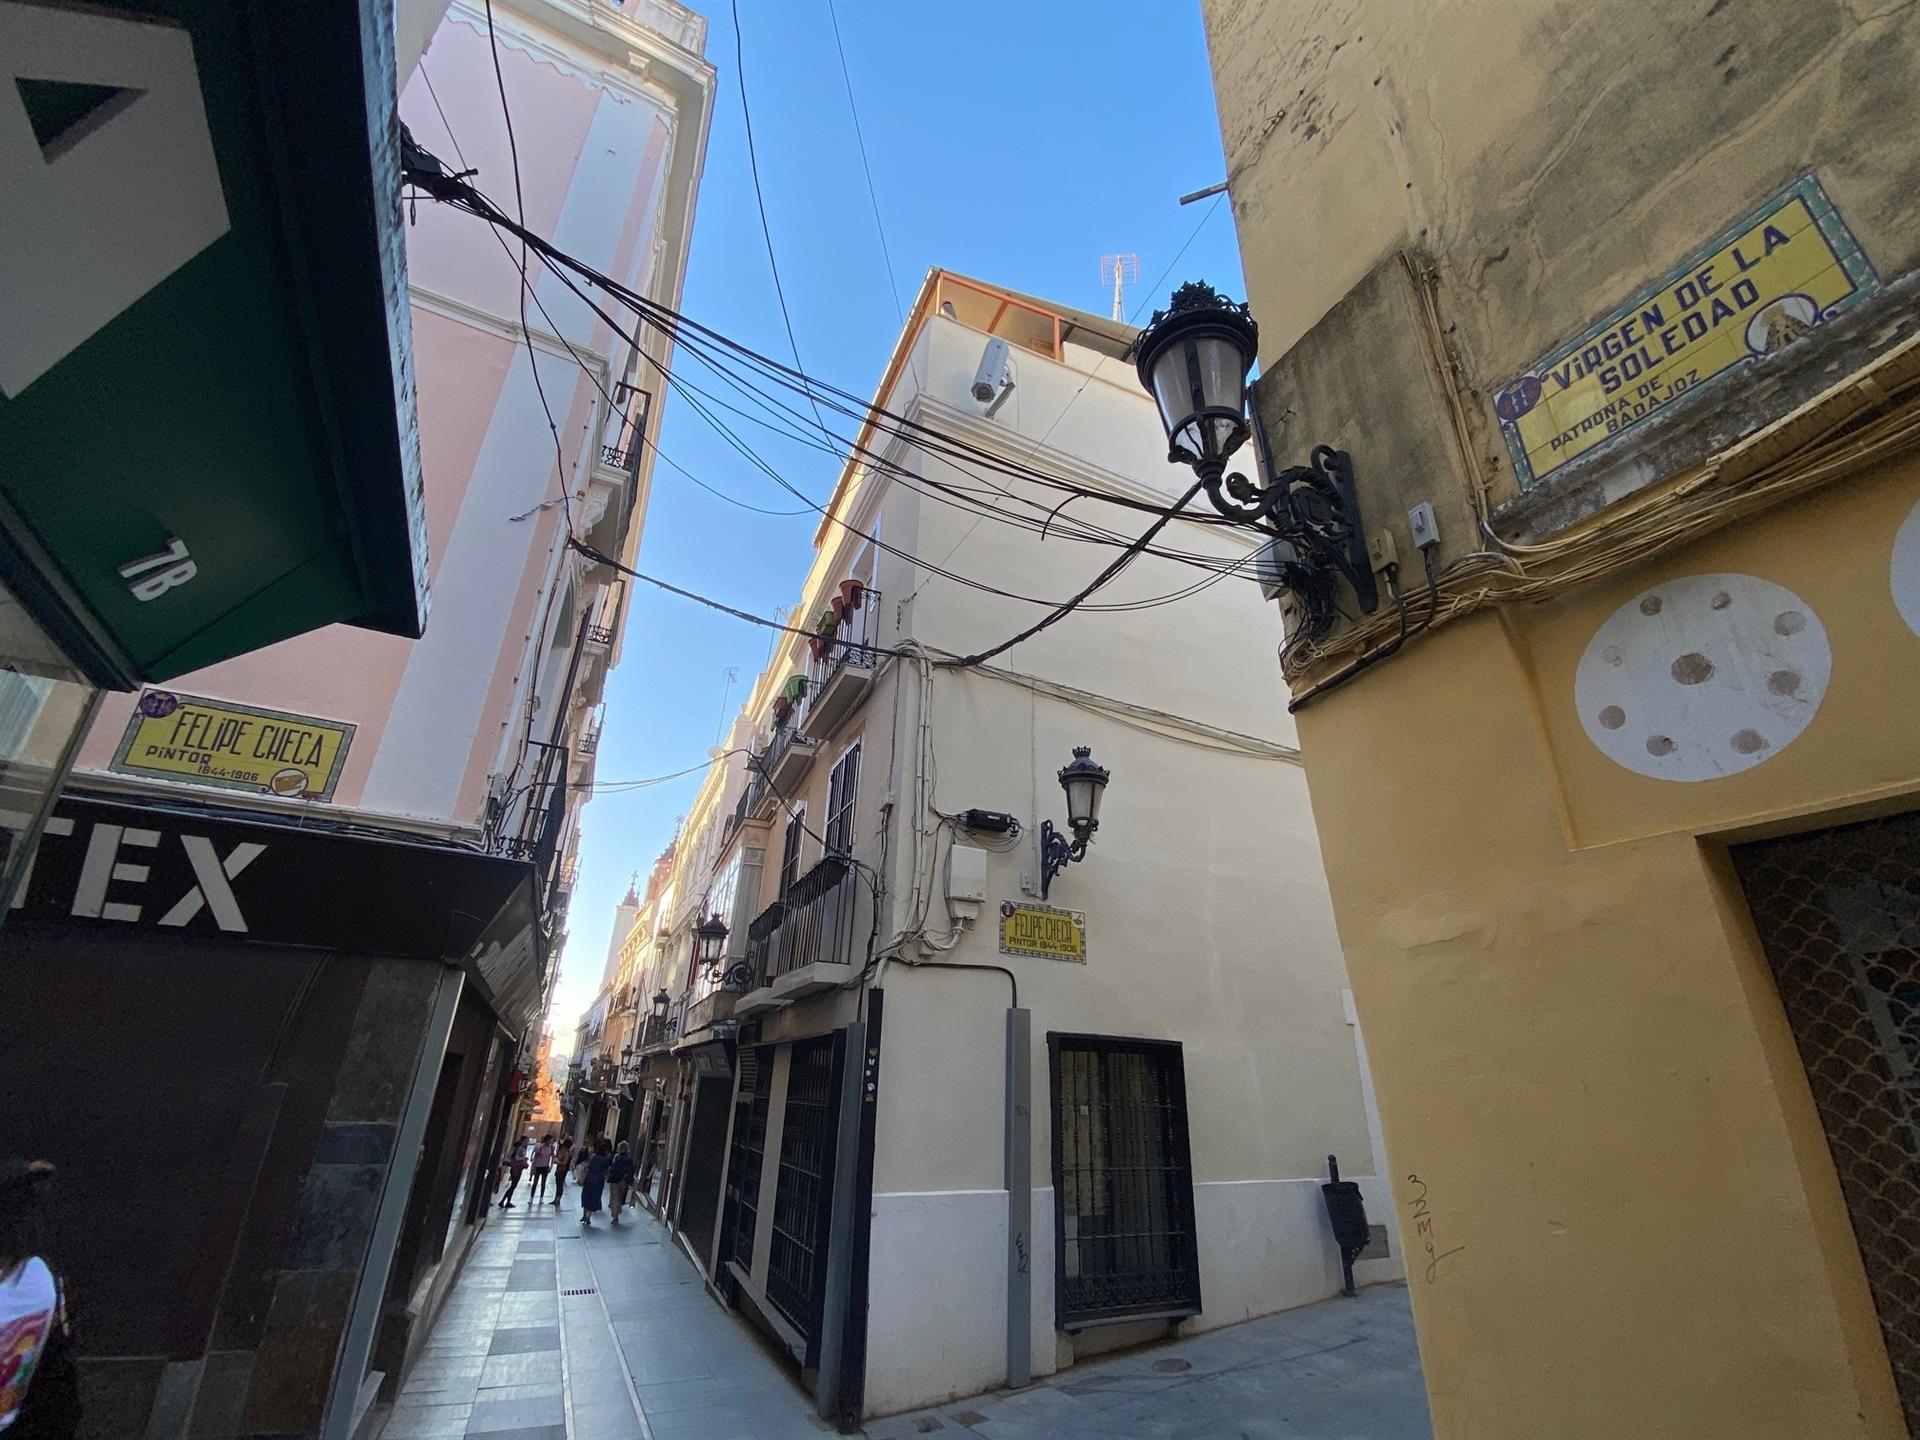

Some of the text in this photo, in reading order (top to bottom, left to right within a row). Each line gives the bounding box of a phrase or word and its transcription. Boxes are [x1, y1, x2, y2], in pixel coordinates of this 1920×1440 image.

[1674, 265, 1723, 312] DE
[1732, 224, 1790, 272] LA
[1600, 278, 1760, 394] SOLEDAD
[1551, 375, 1663, 452] PATRONA DE
[1605, 369, 1700, 434] BADAJOZ
[119, 538, 197, 601] 7B
[198, 764, 259, 782] 1844-1906
[252, 724, 324, 768] CHECA
[1009, 936, 1038, 948] PINTOR
[1014, 912, 1072, 943] FELIPE CHECA
